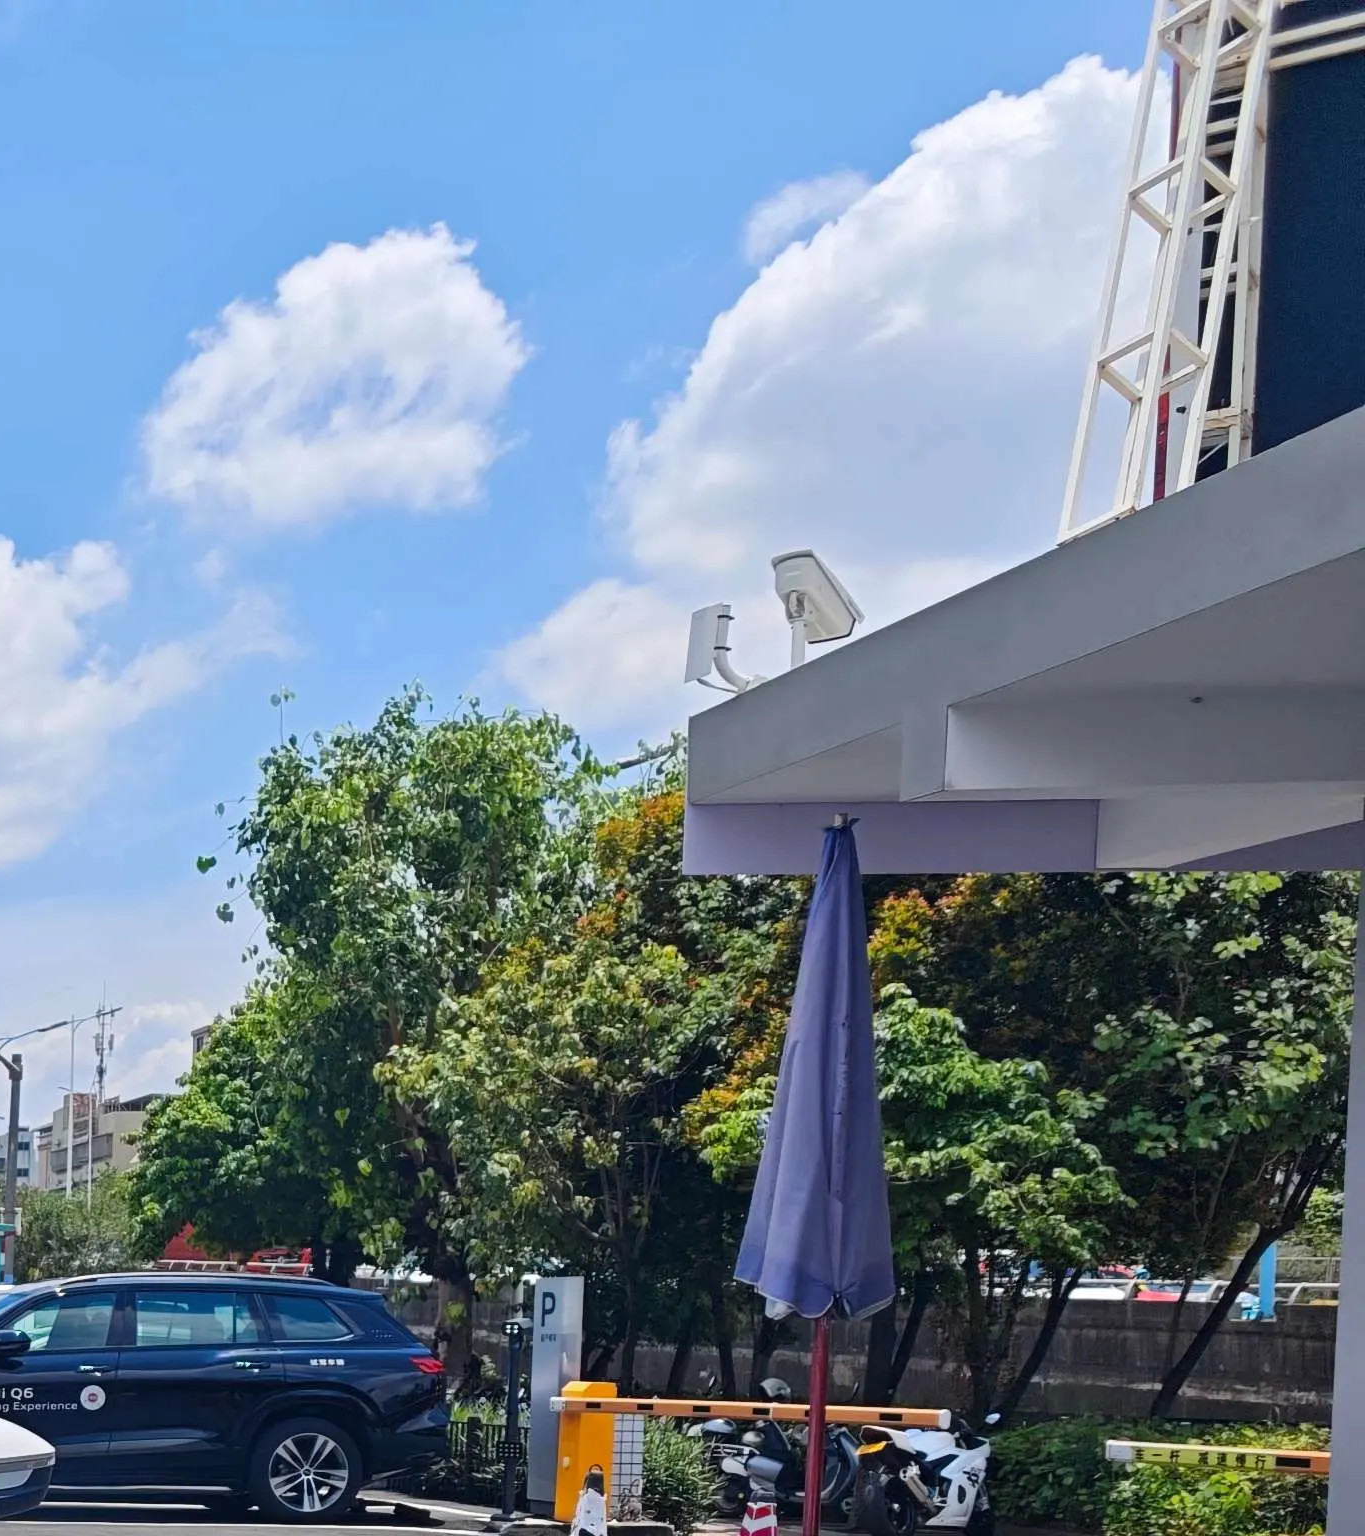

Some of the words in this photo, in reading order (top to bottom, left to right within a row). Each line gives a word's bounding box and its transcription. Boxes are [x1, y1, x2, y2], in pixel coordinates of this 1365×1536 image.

[541, 1291, 556, 1327] P
[10, 1387, 34, 1400] Q6
[13, 1401, 78, 1412] Experience
